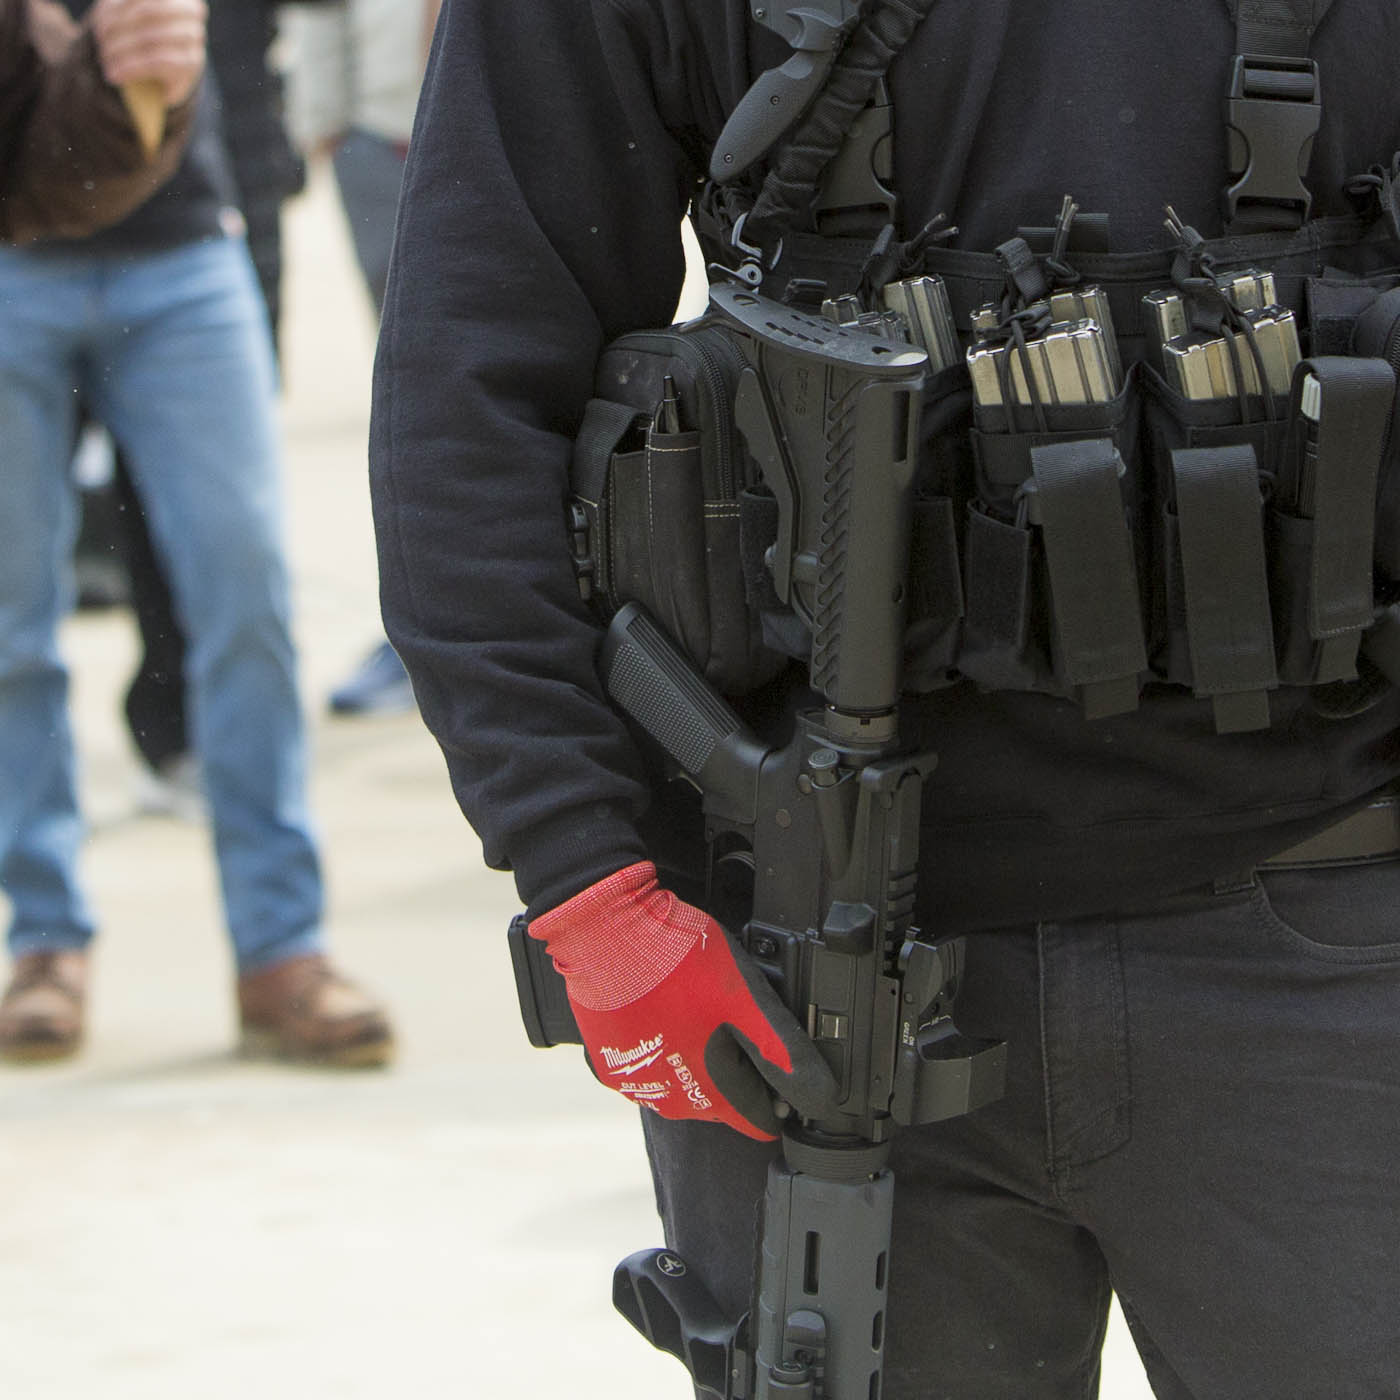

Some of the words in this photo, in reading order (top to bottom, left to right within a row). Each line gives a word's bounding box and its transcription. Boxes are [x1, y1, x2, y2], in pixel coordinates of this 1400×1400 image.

[600, 1035, 663, 1069] Milwaukee
[621, 1081, 636, 1089] CUT
[638, 1081, 665, 1090] LEVEL
